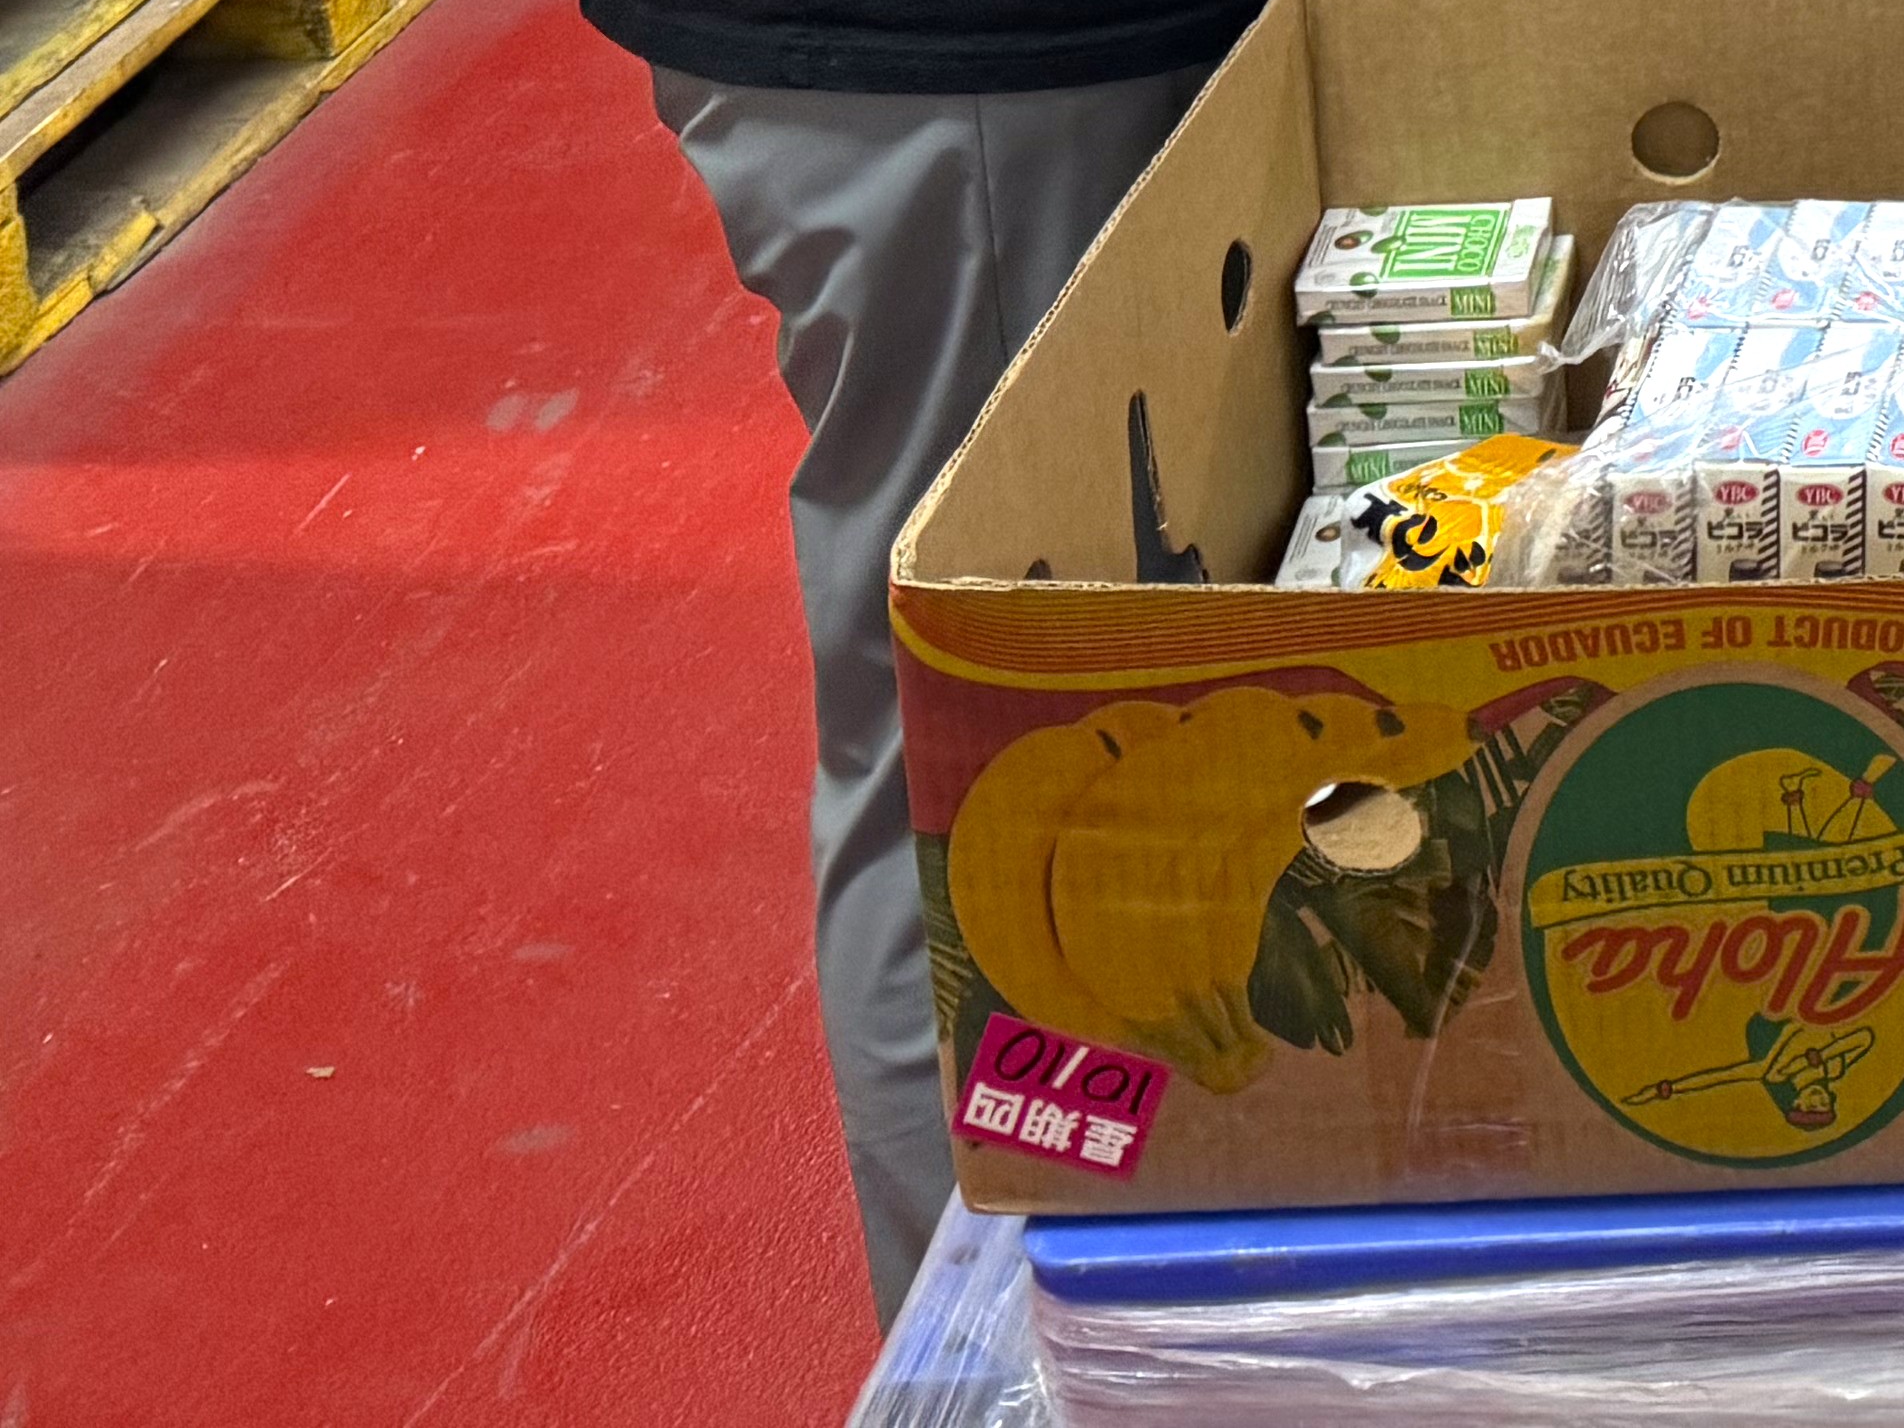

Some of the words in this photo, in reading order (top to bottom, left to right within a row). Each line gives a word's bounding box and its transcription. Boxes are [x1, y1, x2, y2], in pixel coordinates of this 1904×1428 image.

[1393, 213, 1473, 273] MINI
[1457, 214, 1495, 273] CHOCO
[1452, 289, 1494, 315] MINI
[1719, 483, 1755, 505] YBC
[1802, 485, 1840, 506] YBC
[1487, 619, 1686, 672] ECUADOR
[1702, 613, 1753, 647] OF
[1559, 861, 1714, 905] Quality
[962, 1080, 1139, 1168] 星期四
